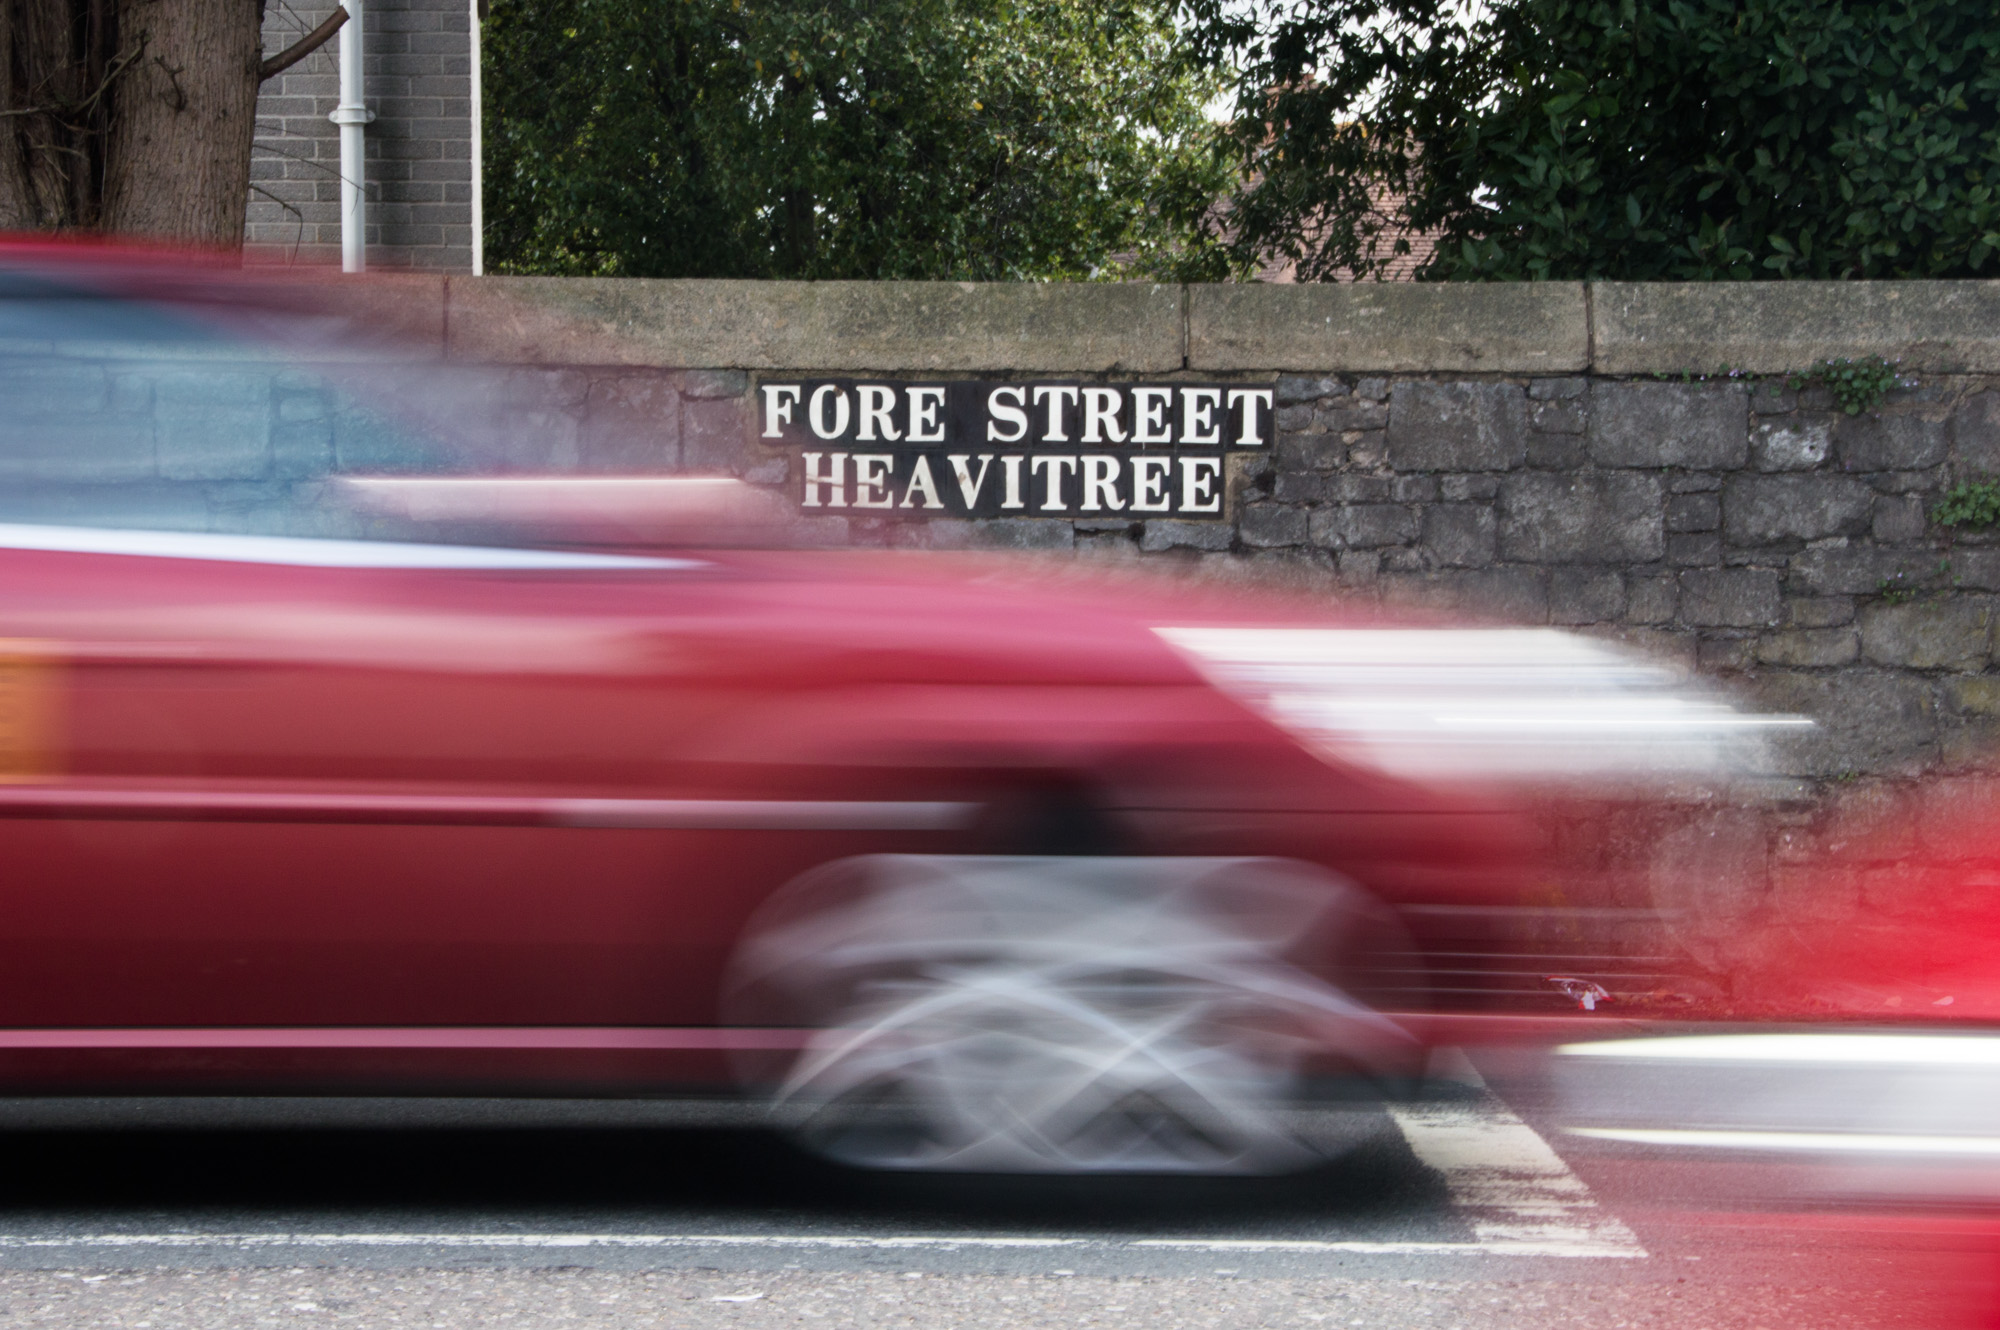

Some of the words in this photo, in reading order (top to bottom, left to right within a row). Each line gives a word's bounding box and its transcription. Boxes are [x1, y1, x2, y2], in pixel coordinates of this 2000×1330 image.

[761, 384, 946, 442] FORE
[987, 386, 1273, 446] STREET
[801, 452, 1221, 513] HEAVITREE
